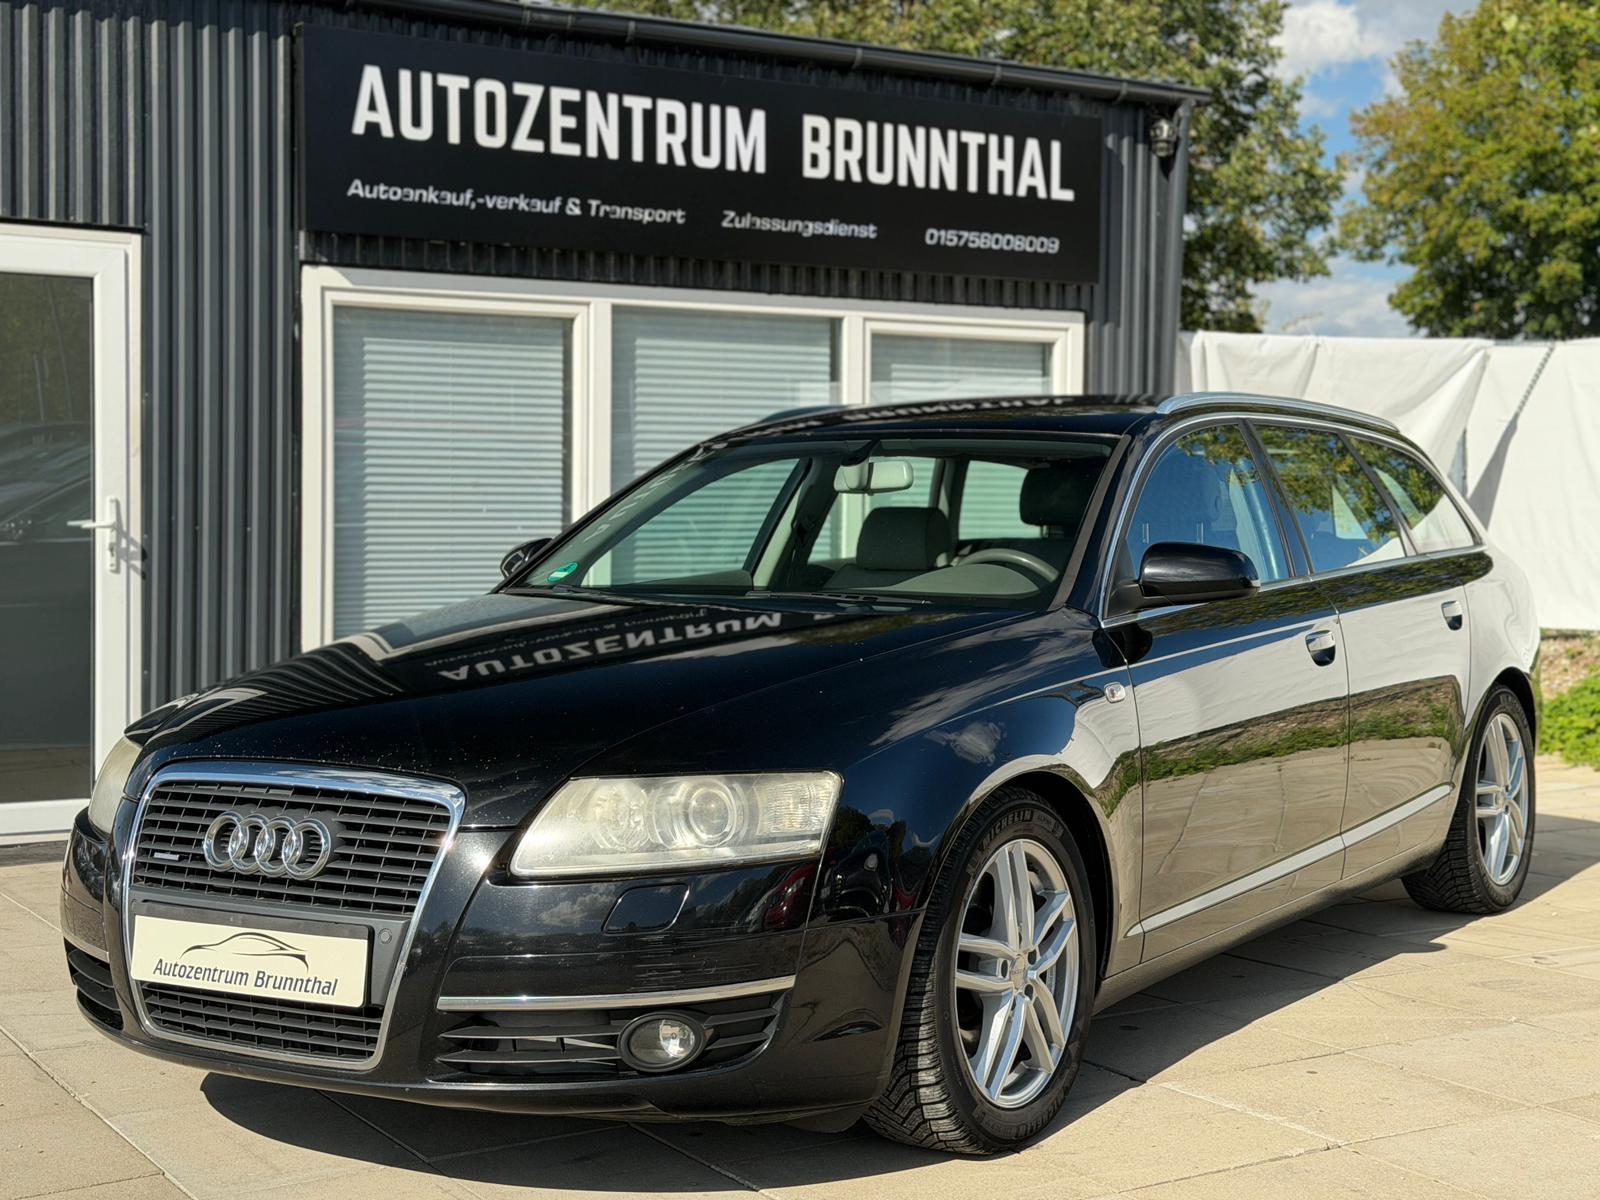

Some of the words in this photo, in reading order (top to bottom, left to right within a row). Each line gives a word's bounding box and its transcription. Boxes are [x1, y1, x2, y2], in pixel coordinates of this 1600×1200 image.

[352, 64, 766, 173] AUTOZENTRUM
[802, 114, 1075, 201] BRUNNTHAL
[565, 198, 582, 216] &
[587, 199, 687, 224] Transport
[721, 209, 878, 238] Zulassungsdienst
[924, 228, 1060, 254] 015758008009
[153, 958, 249, 987] Autozentrum
[254, 971, 338, 996] Brunnthal
